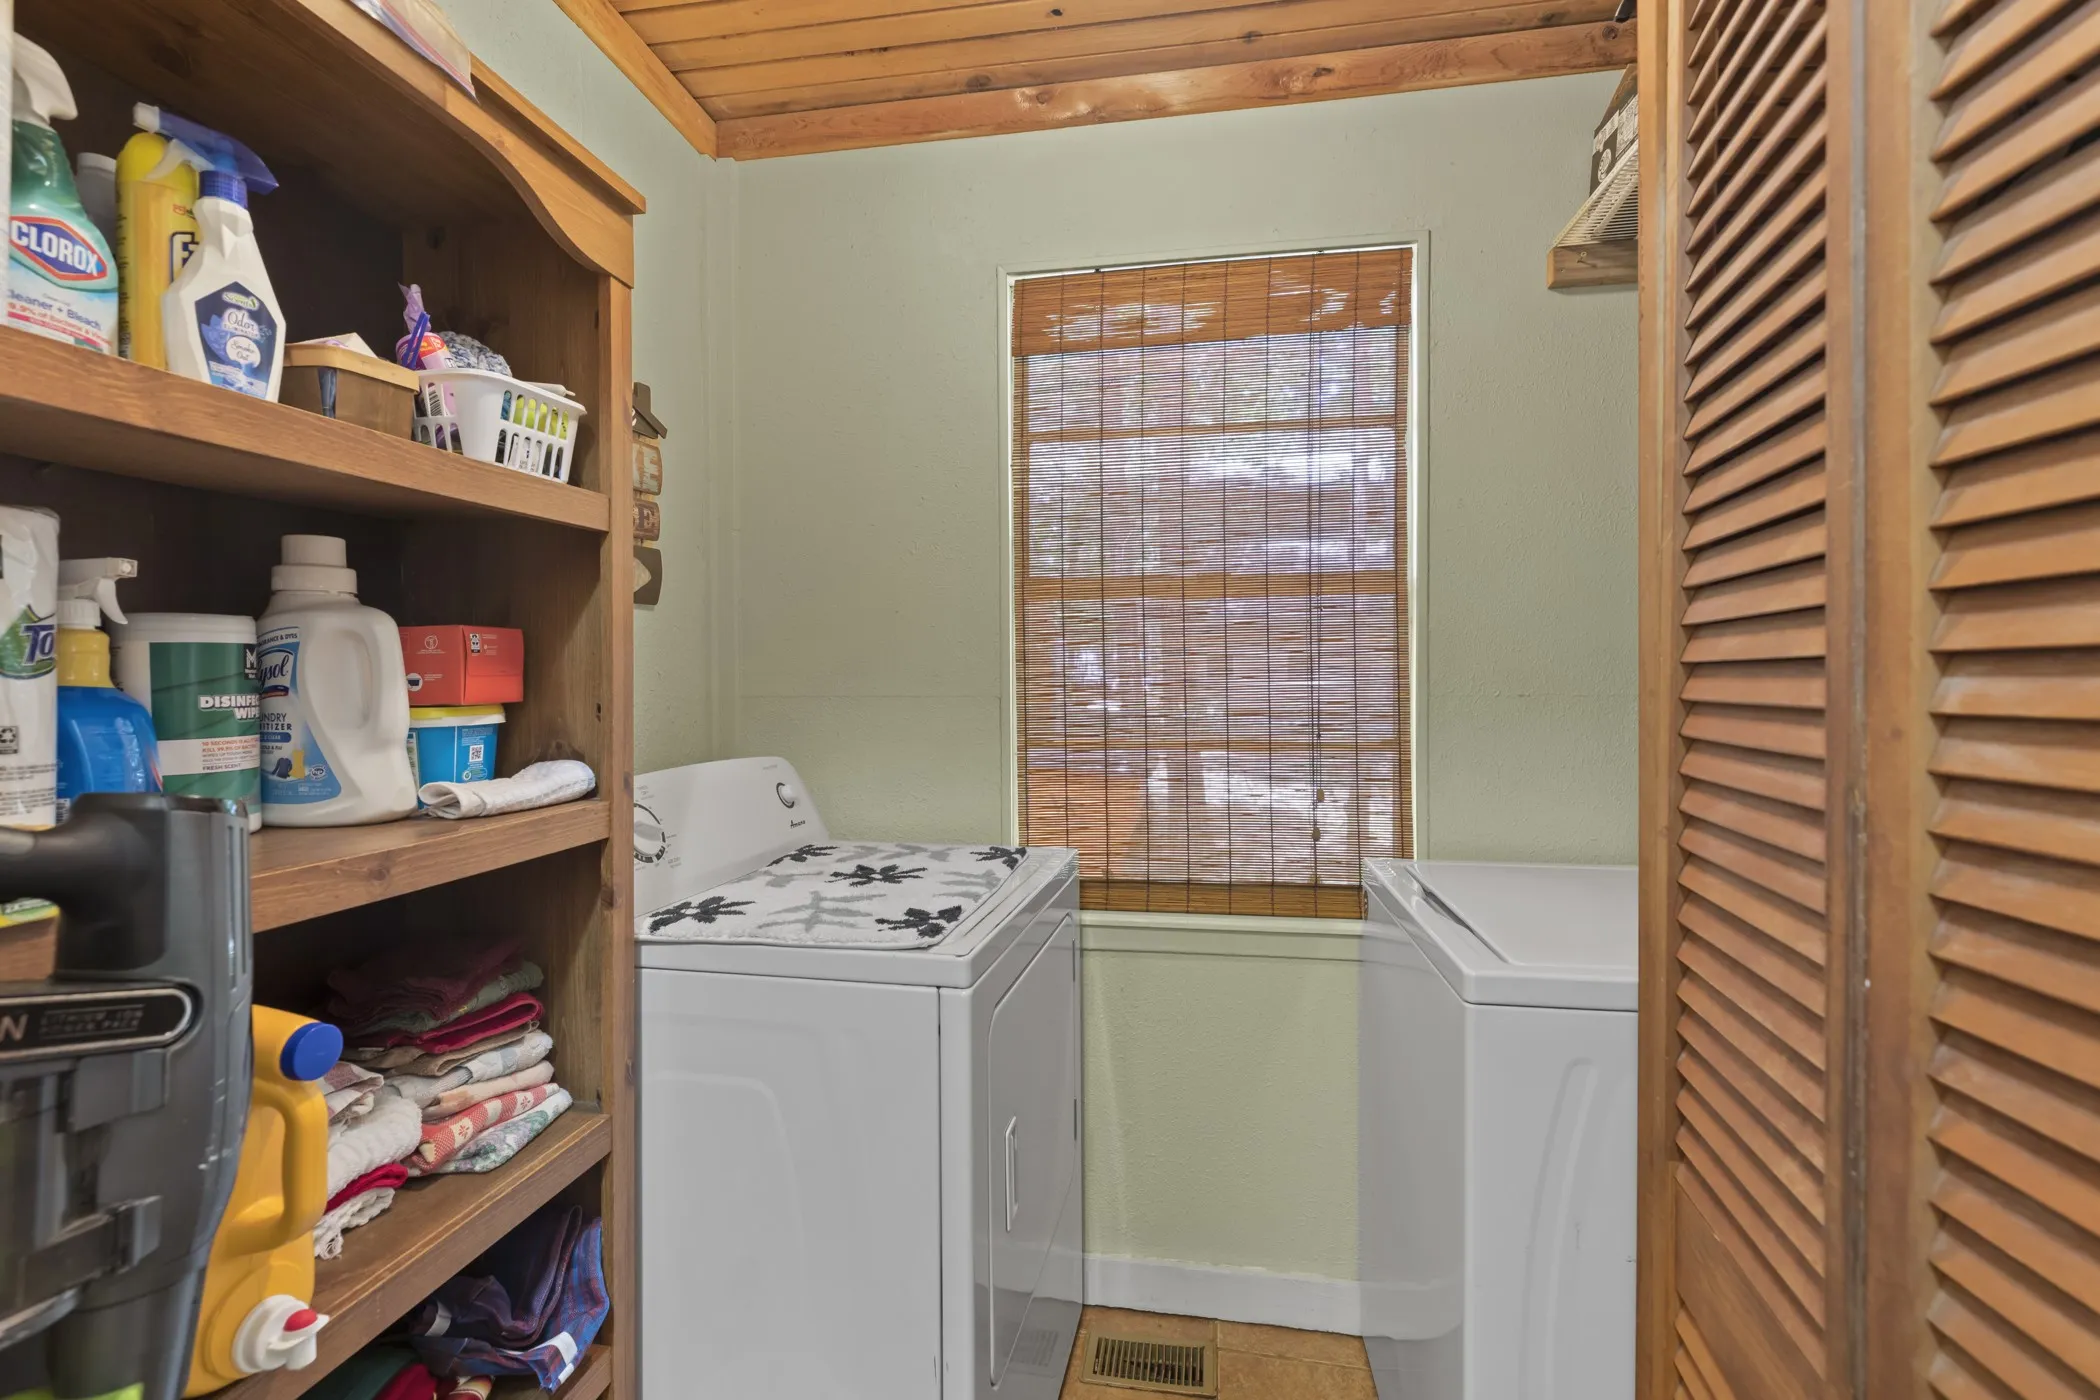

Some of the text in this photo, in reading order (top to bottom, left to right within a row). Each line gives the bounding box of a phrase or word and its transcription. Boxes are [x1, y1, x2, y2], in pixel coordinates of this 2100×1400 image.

[11, 219, 98, 277] CLOROX
[67, 309, 101, 330] Bleach
[228, 311, 255, 331] Odor
[285, 632, 298, 640] DYES
